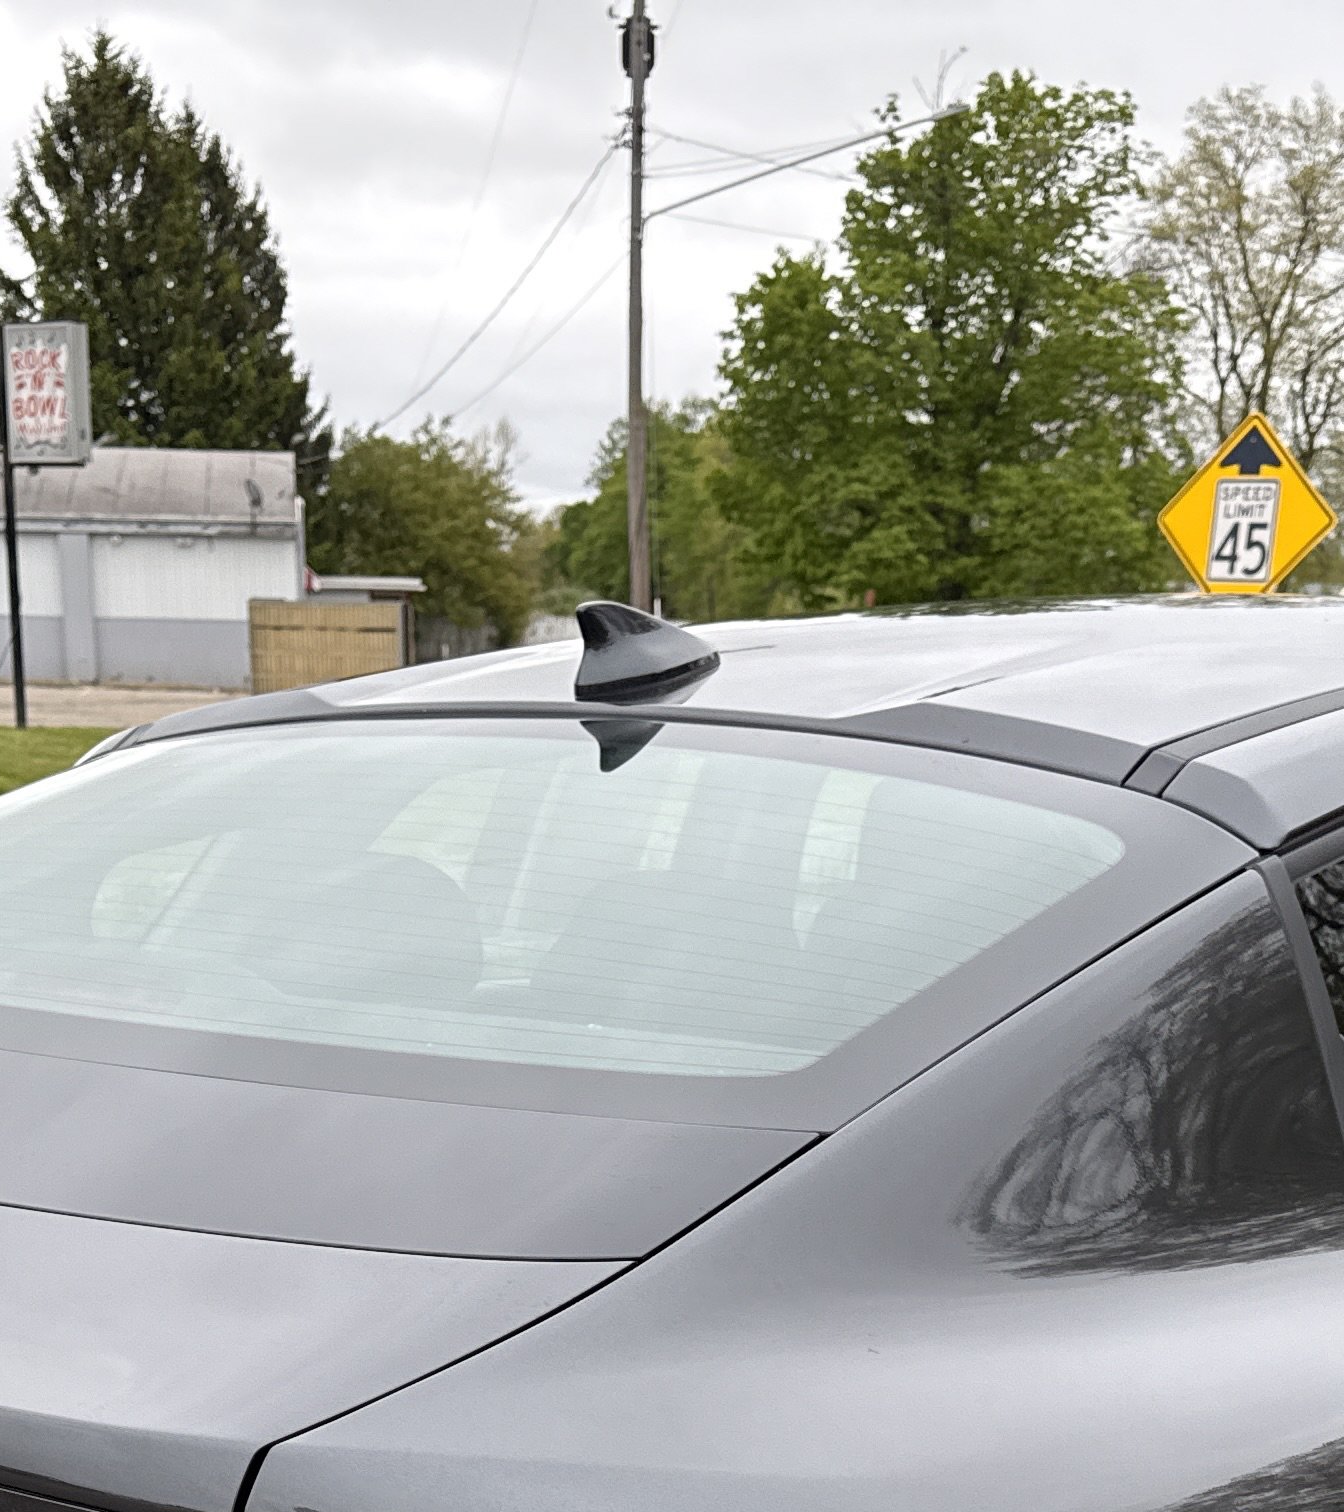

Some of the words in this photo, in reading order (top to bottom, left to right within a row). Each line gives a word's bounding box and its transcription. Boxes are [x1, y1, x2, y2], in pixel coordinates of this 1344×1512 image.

[10, 348, 63, 371] ROCK
[12, 394, 70, 421] BOWL
[1221, 486, 1275, 501] SPEED
[1223, 503, 1266, 519] LIMIT
[1214, 522, 1268, 575] 45
